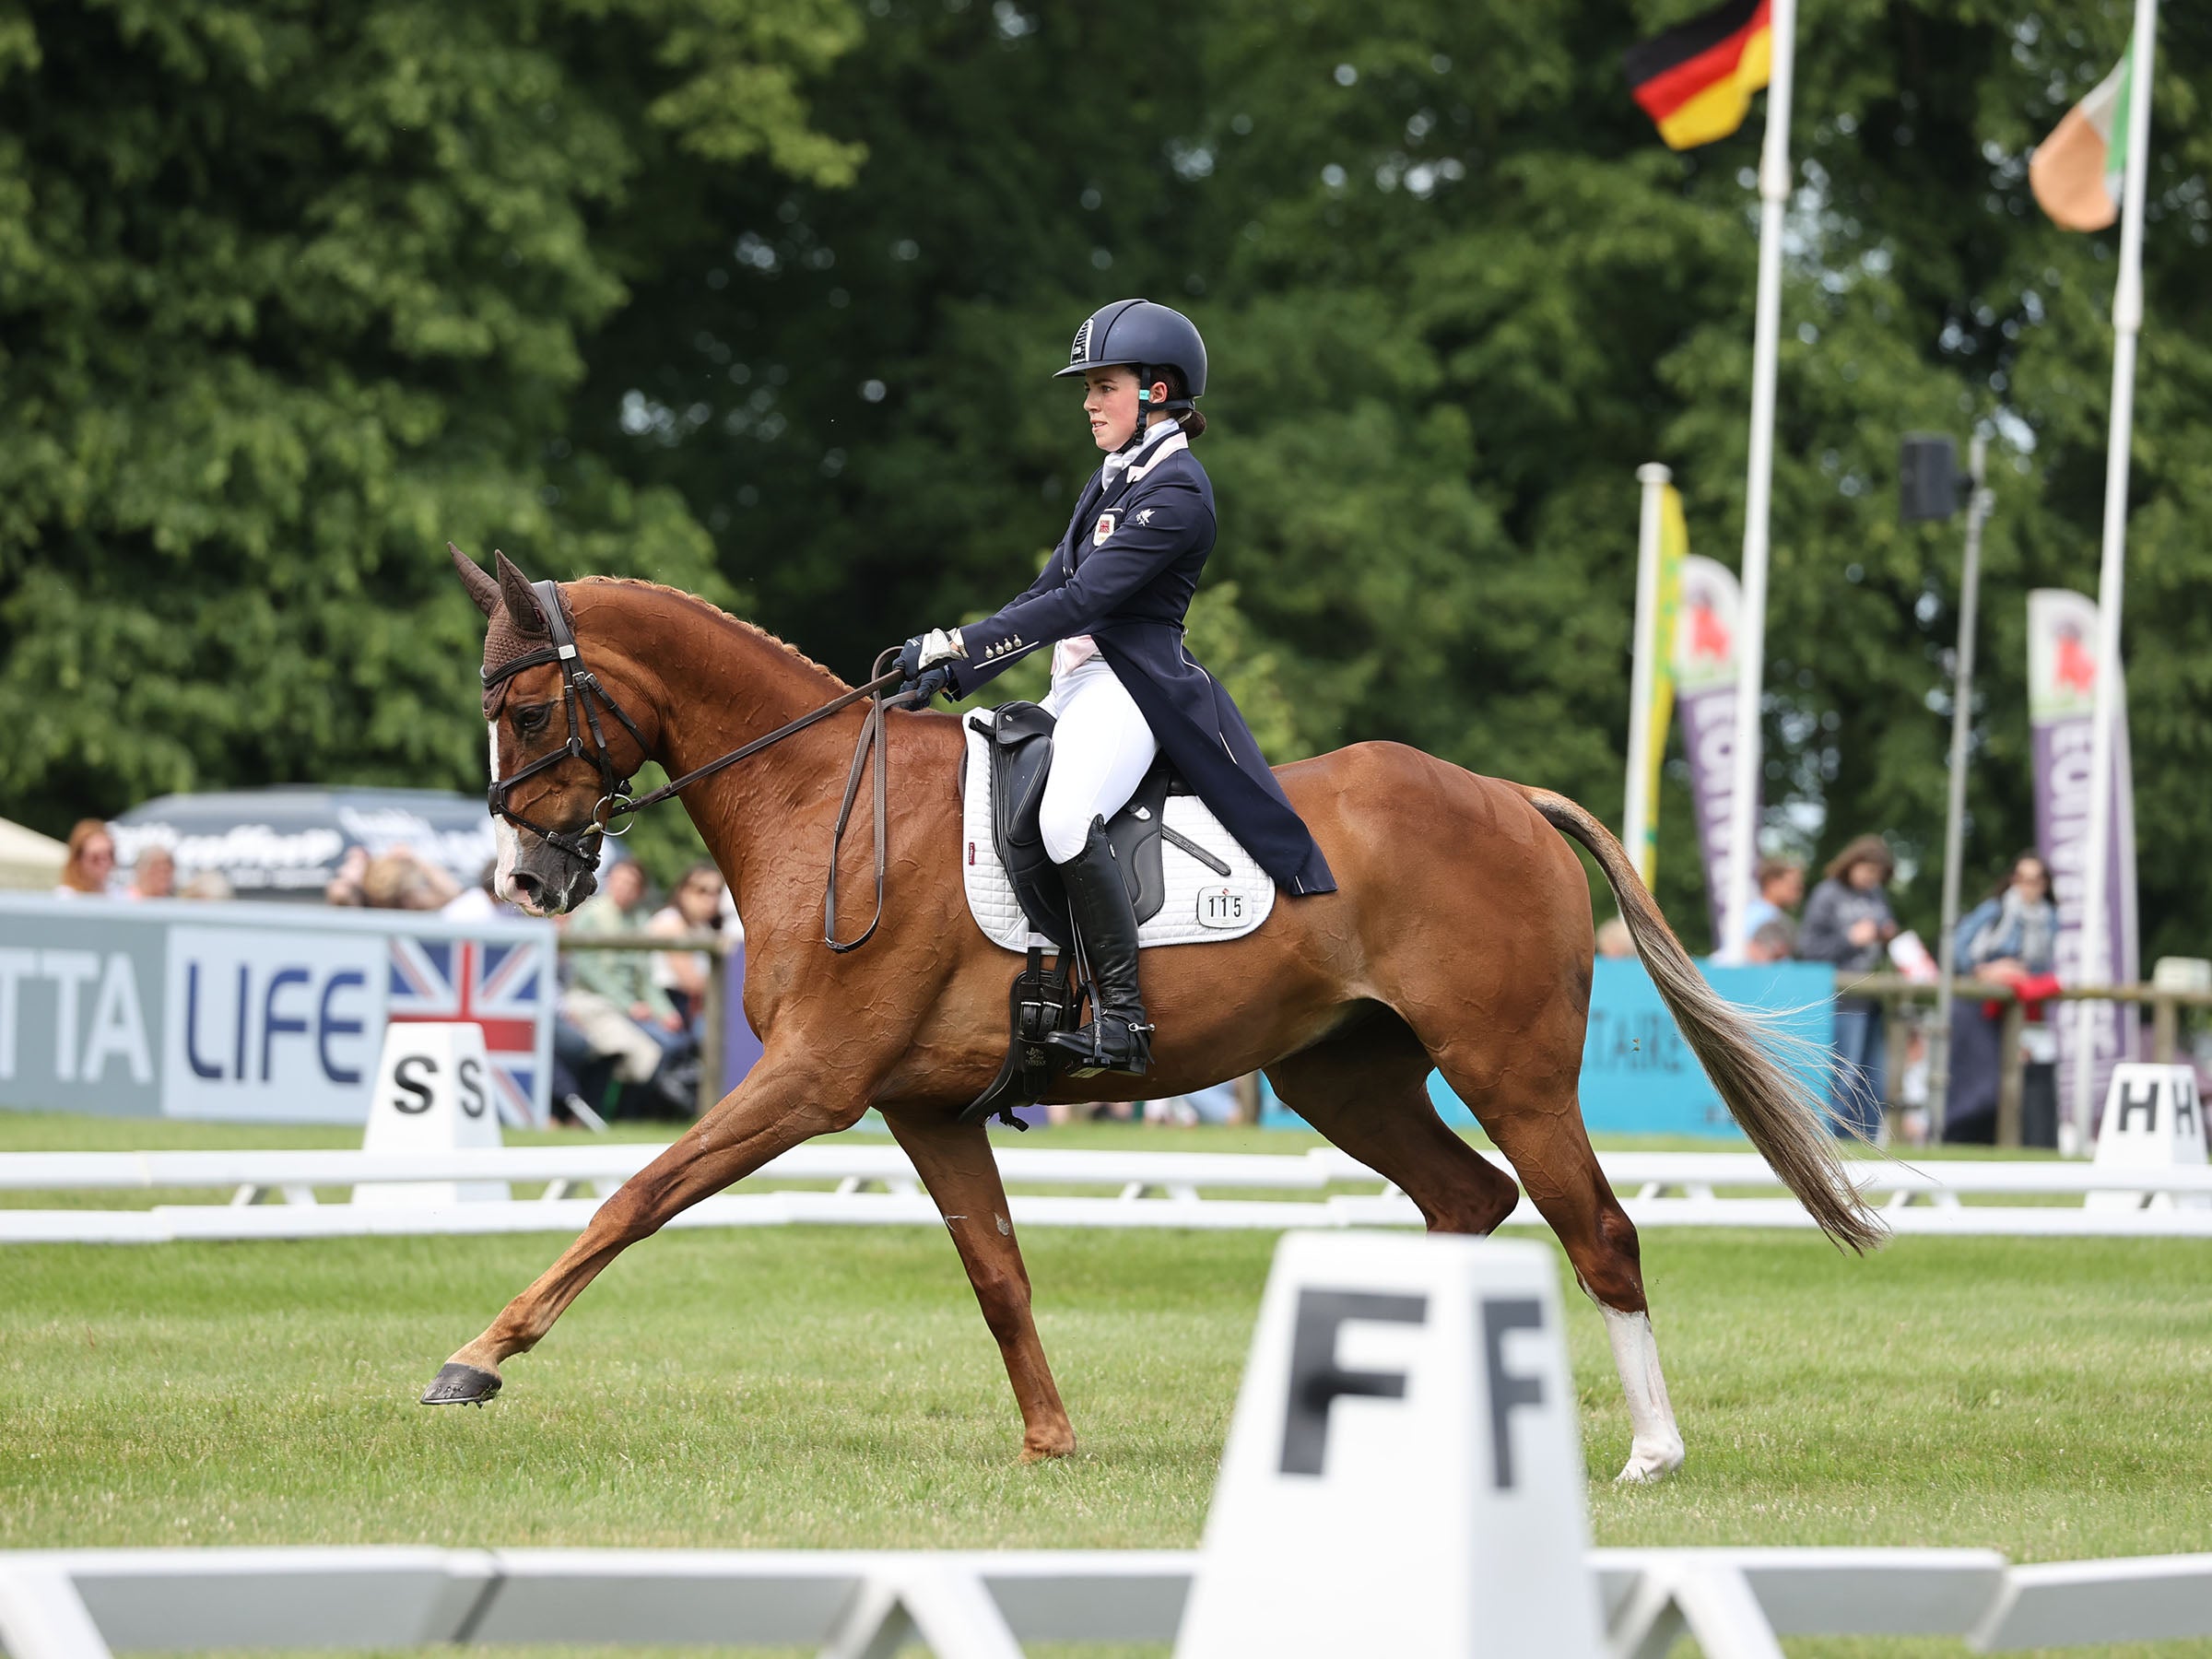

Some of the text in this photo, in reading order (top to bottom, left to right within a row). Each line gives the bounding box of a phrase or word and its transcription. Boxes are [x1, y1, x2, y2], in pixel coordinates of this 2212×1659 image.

[1209, 897, 1241, 917] 115
[186, 959, 366, 1085] LIFE
[392, 1055, 438, 1114] S
[460, 1056, 486, 1119] S
[2118, 1081, 2159, 1132] H
[2171, 1080, 2195, 1136] H
[1278, 1287, 1429, 1477] F
[1482, 1299, 1544, 1489] F
